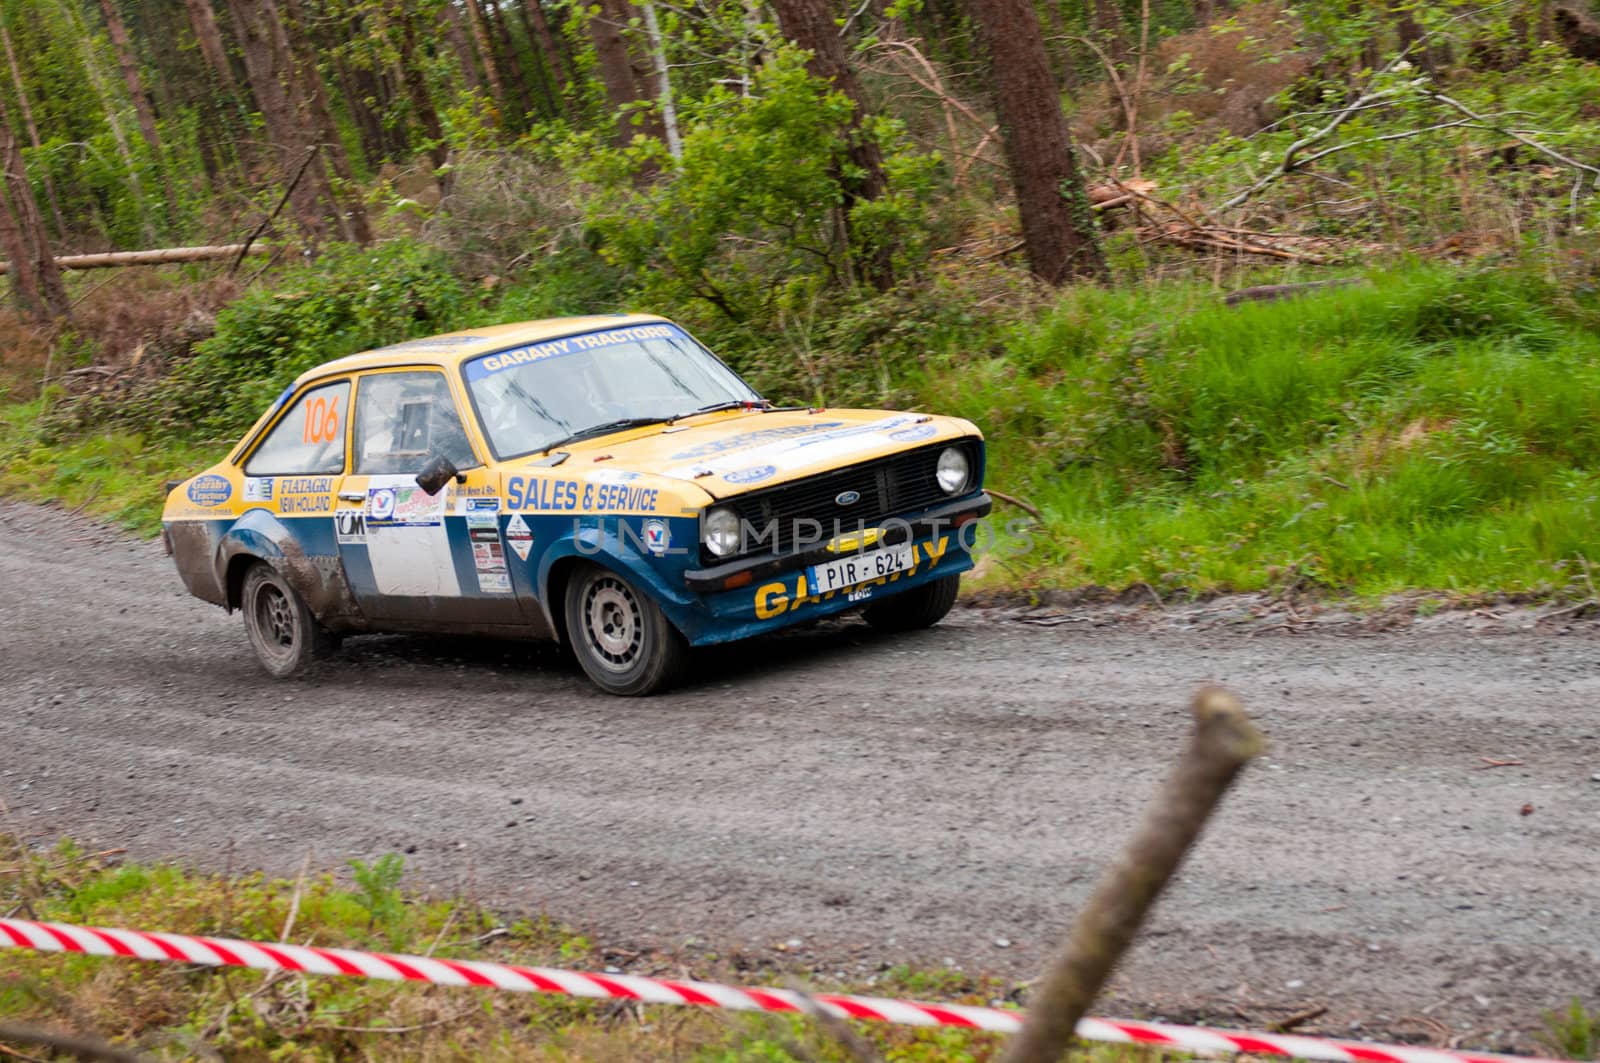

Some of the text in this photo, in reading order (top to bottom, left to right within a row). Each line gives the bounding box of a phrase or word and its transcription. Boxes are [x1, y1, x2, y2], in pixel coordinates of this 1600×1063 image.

[482, 338, 570, 371] GARAHY
[571, 326, 673, 349] TRACTORS
[303, 395, 339, 444] 106
[279, 496, 331, 512] NEW HOLLAND
[281, 478, 334, 494] FIATAGRI
[507, 476, 578, 510] SALES
[582, 483, 594, 511] &
[597, 485, 658, 511] SERVICE
[827, 564, 857, 589] PIR
[875, 551, 903, 575] 624
